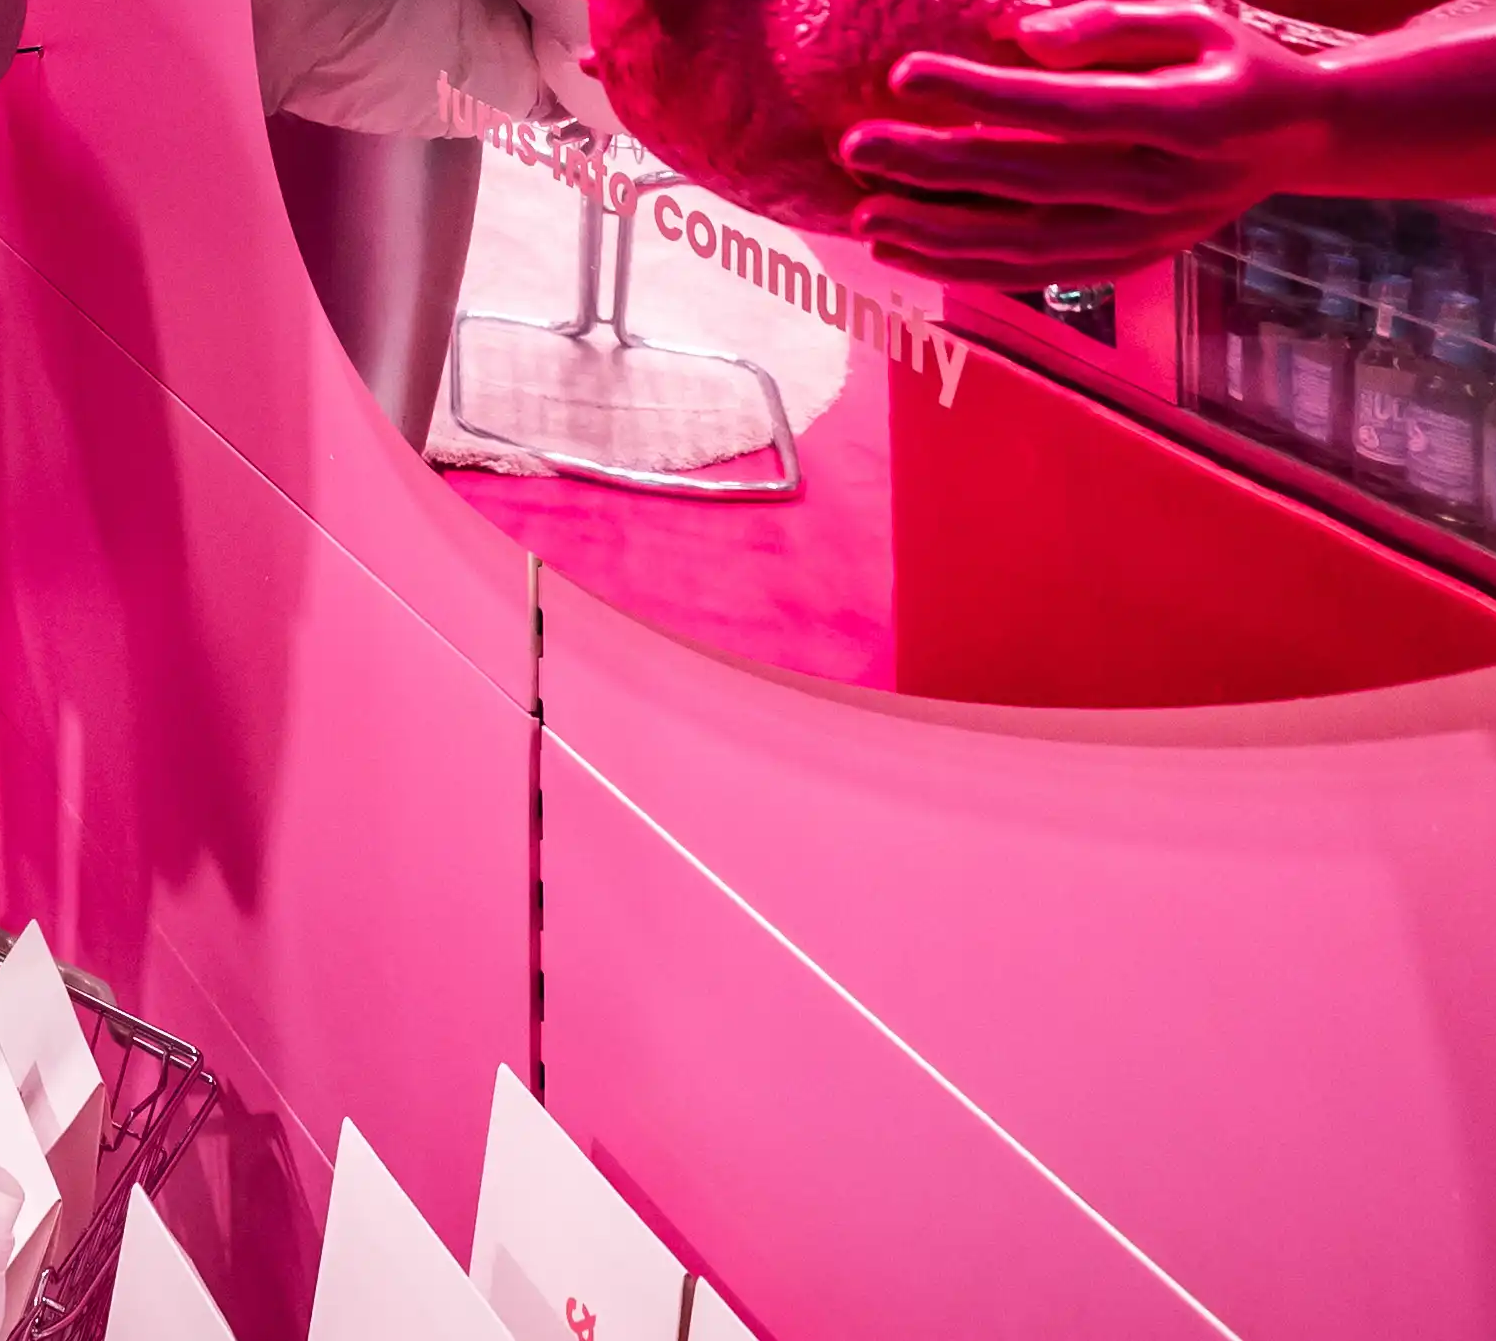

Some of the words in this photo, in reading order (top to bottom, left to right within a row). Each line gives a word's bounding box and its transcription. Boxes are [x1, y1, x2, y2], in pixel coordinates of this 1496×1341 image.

[437, 70, 538, 167] turns
[552, 124, 638, 218] into
[655, 194, 969, 410] community
